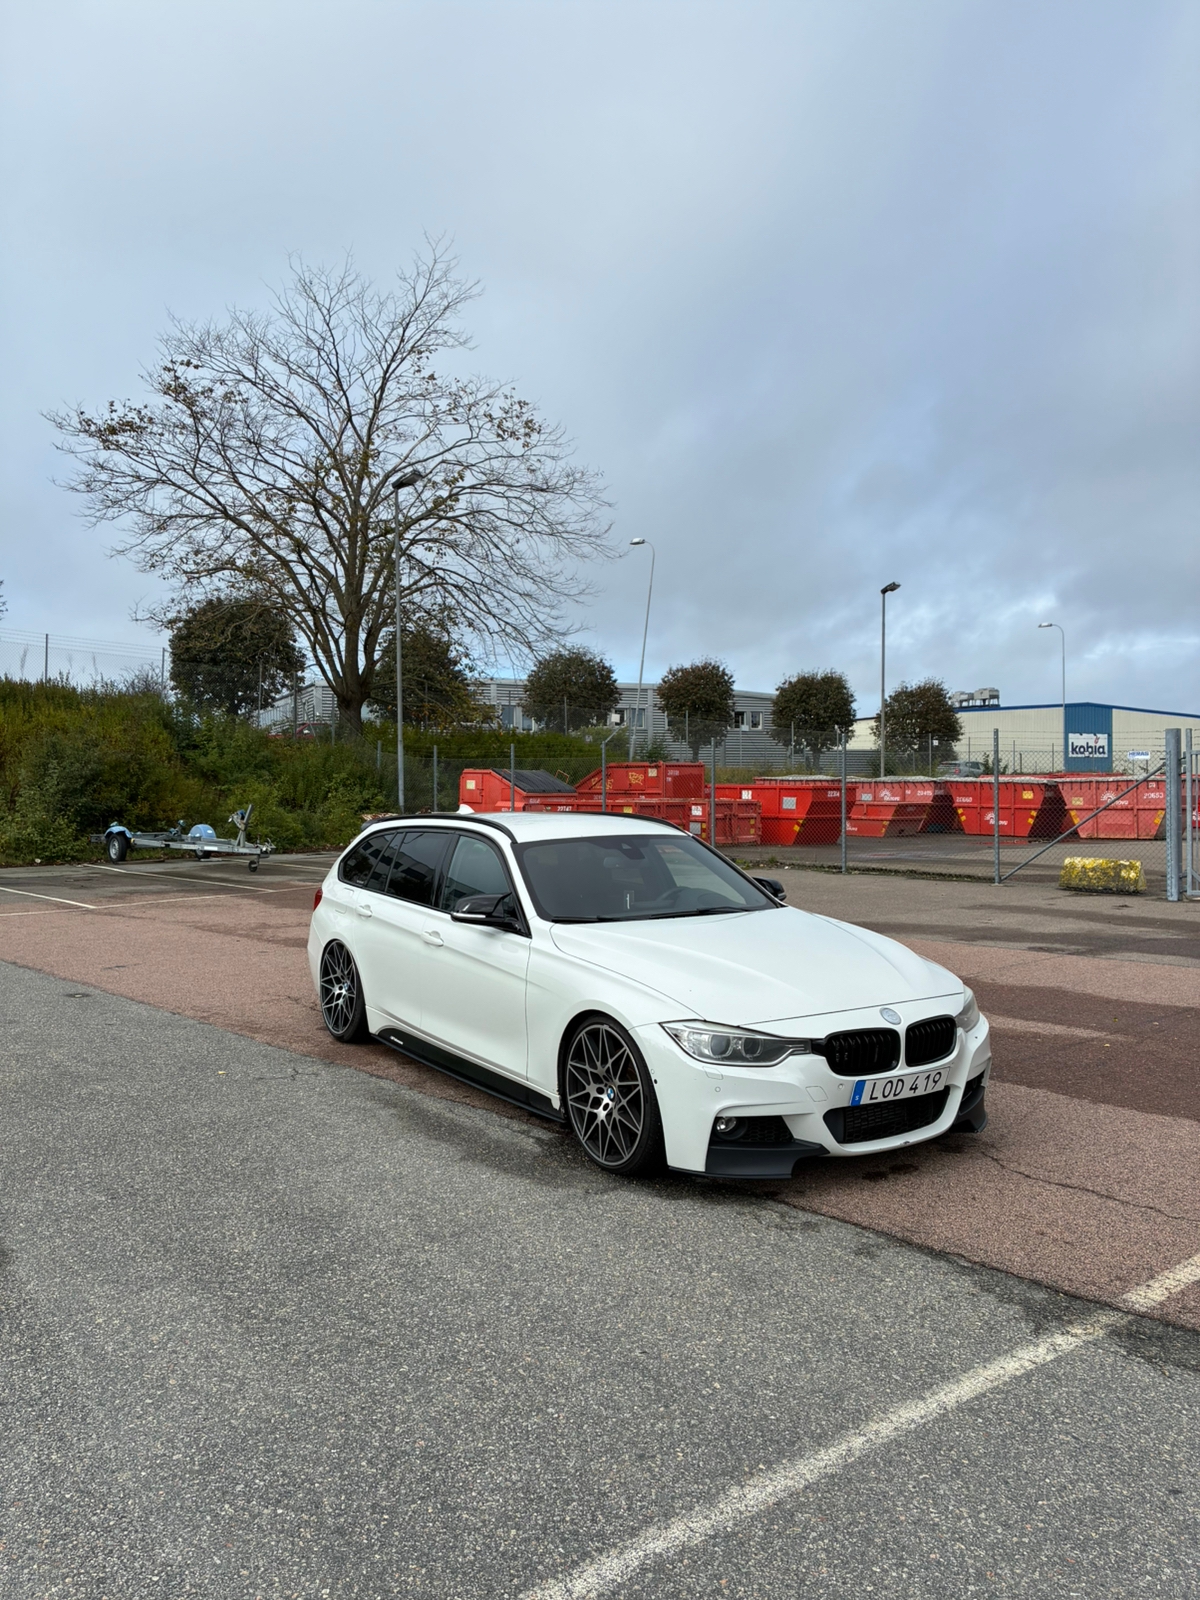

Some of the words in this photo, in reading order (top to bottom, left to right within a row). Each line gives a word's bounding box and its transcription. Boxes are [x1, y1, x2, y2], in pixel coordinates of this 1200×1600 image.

[1070, 741, 1106, 755] kobia
[869, 1079, 905, 1101] LOD
[908, 1071, 943, 1094] 419
